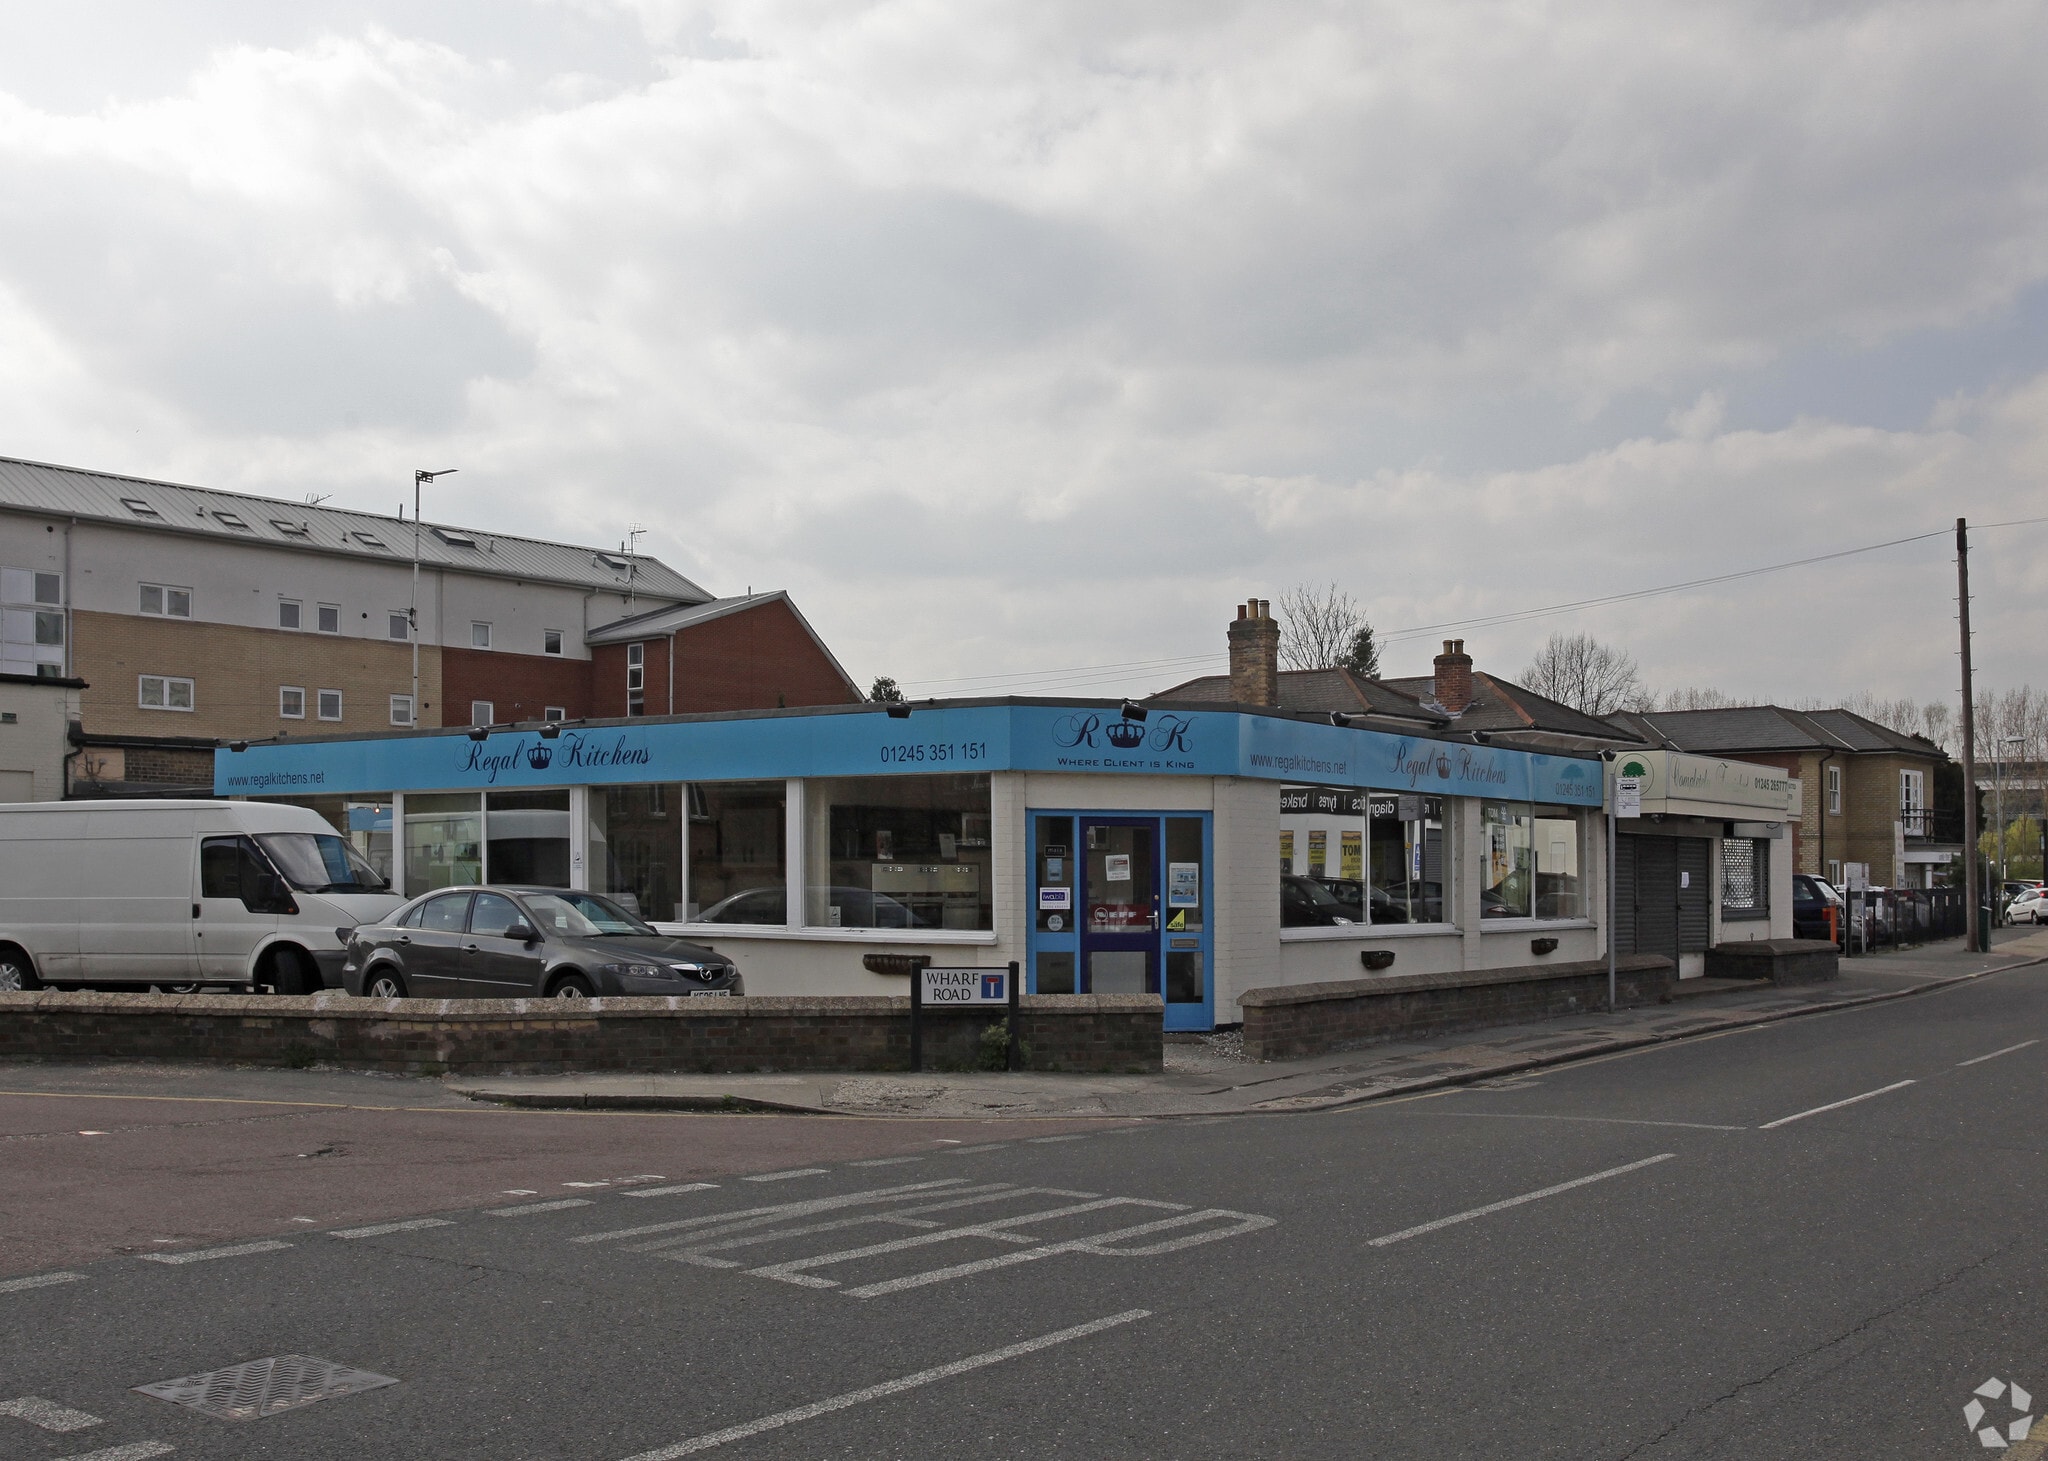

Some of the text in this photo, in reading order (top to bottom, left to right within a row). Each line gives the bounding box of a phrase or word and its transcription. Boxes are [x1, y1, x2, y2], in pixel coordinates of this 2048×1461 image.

[1052, 712, 1200, 753] R K
[454, 733, 654, 783] Regal Kitchens
[880, 742, 986, 763] 01245 351 151
[1057, 757, 1099, 767] WHERE
[1103, 758, 1144, 768] CLIENT
[1166, 760, 1195, 769] KING
[1250, 754, 1347, 775] www.regalkitchens.net
[1385, 742, 1507, 788] Regal Kitchens
[227, 771, 325, 789] www.regalkitchens.net
[1754, 777, 1770, 791] 01245
[1555, 782, 1595, 797] 01245 351 151
[926, 972, 979, 985] WHARF
[933, 988, 971, 1000] ROAD
